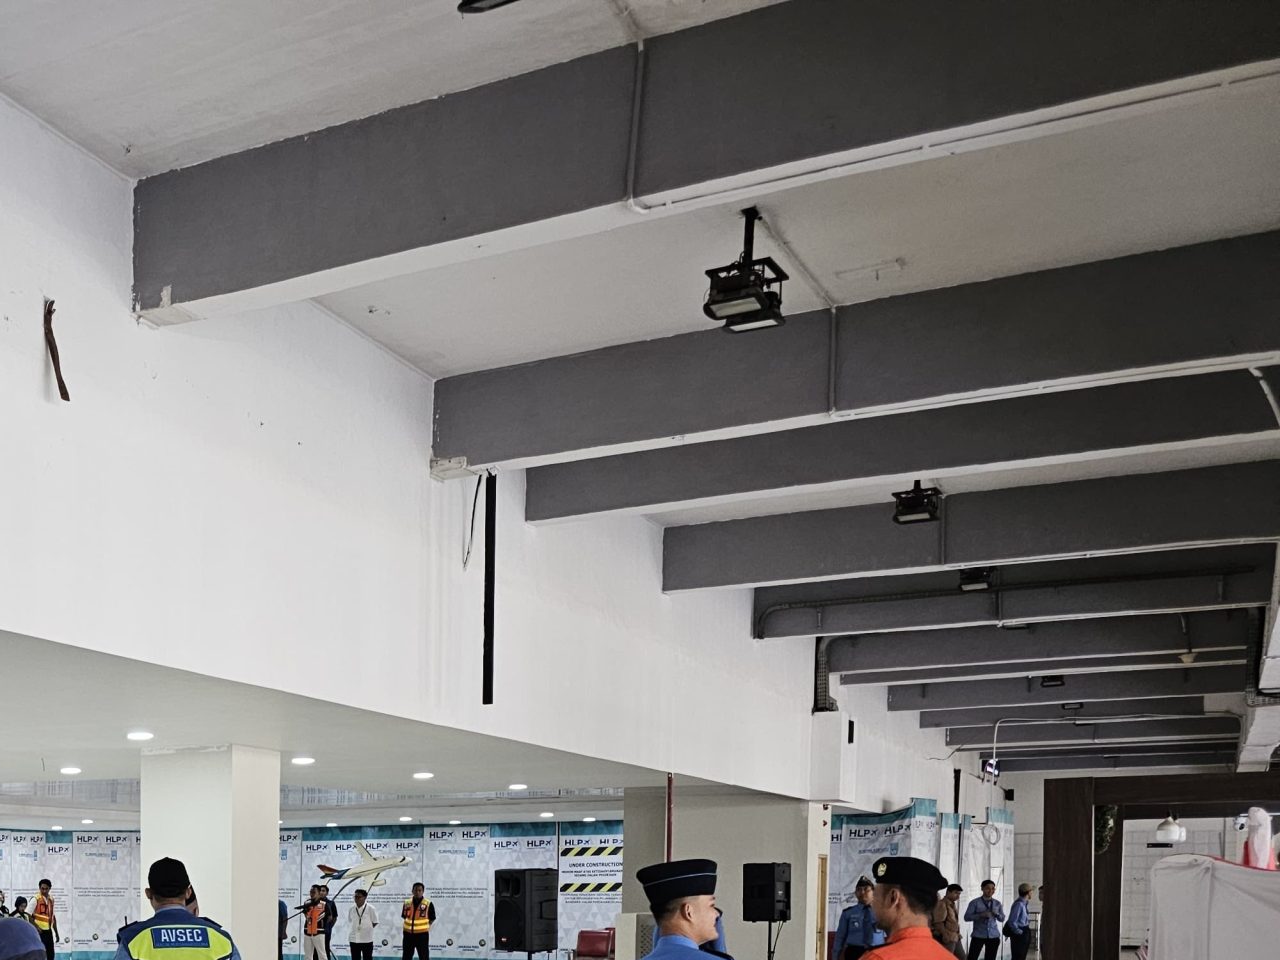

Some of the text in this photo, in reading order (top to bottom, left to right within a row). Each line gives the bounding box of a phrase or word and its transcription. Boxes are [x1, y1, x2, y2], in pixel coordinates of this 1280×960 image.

[849, 829, 870, 838] HLP
[884, 824, 904, 835] HLP
[161, 928, 203, 942] AVSEC
